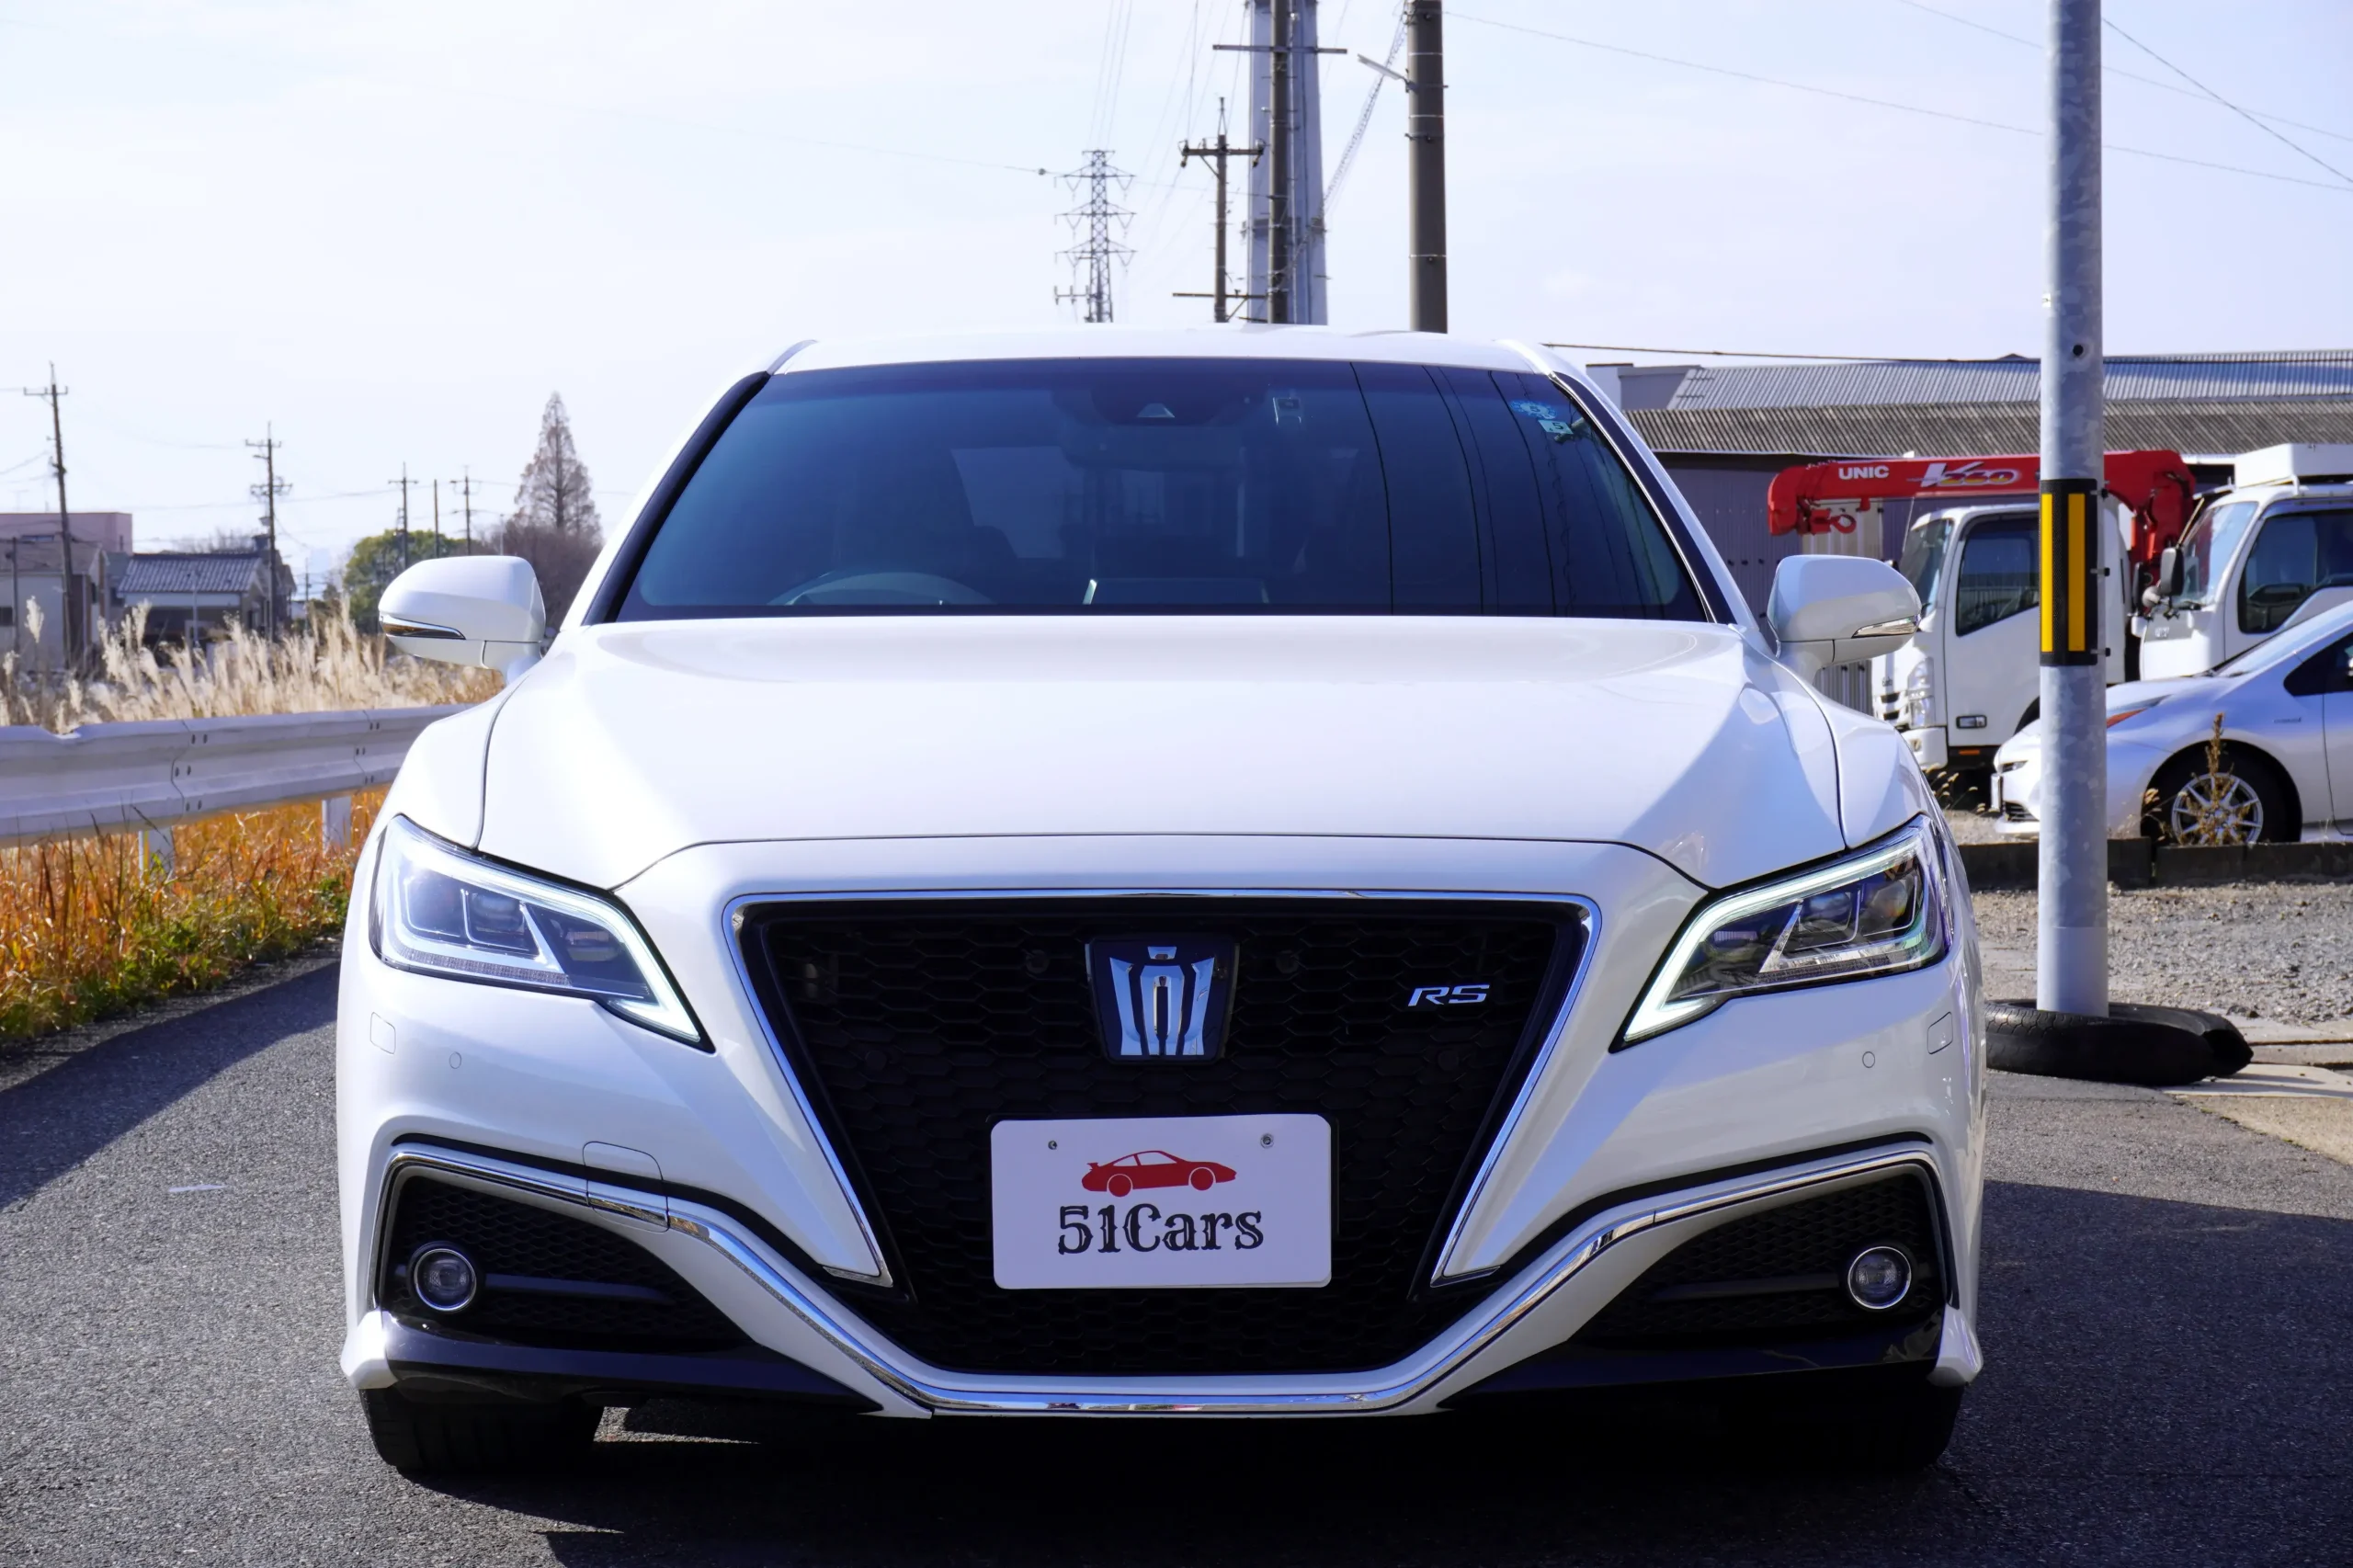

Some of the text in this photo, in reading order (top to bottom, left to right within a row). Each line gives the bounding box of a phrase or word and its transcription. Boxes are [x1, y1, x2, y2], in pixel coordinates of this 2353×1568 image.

[1552, 422, 1564, 430] 5
[1838, 465, 1890, 480] UNIC
[1407, 984, 1490, 1006] RS
[1058, 1203, 1264, 1255] 51Cars
